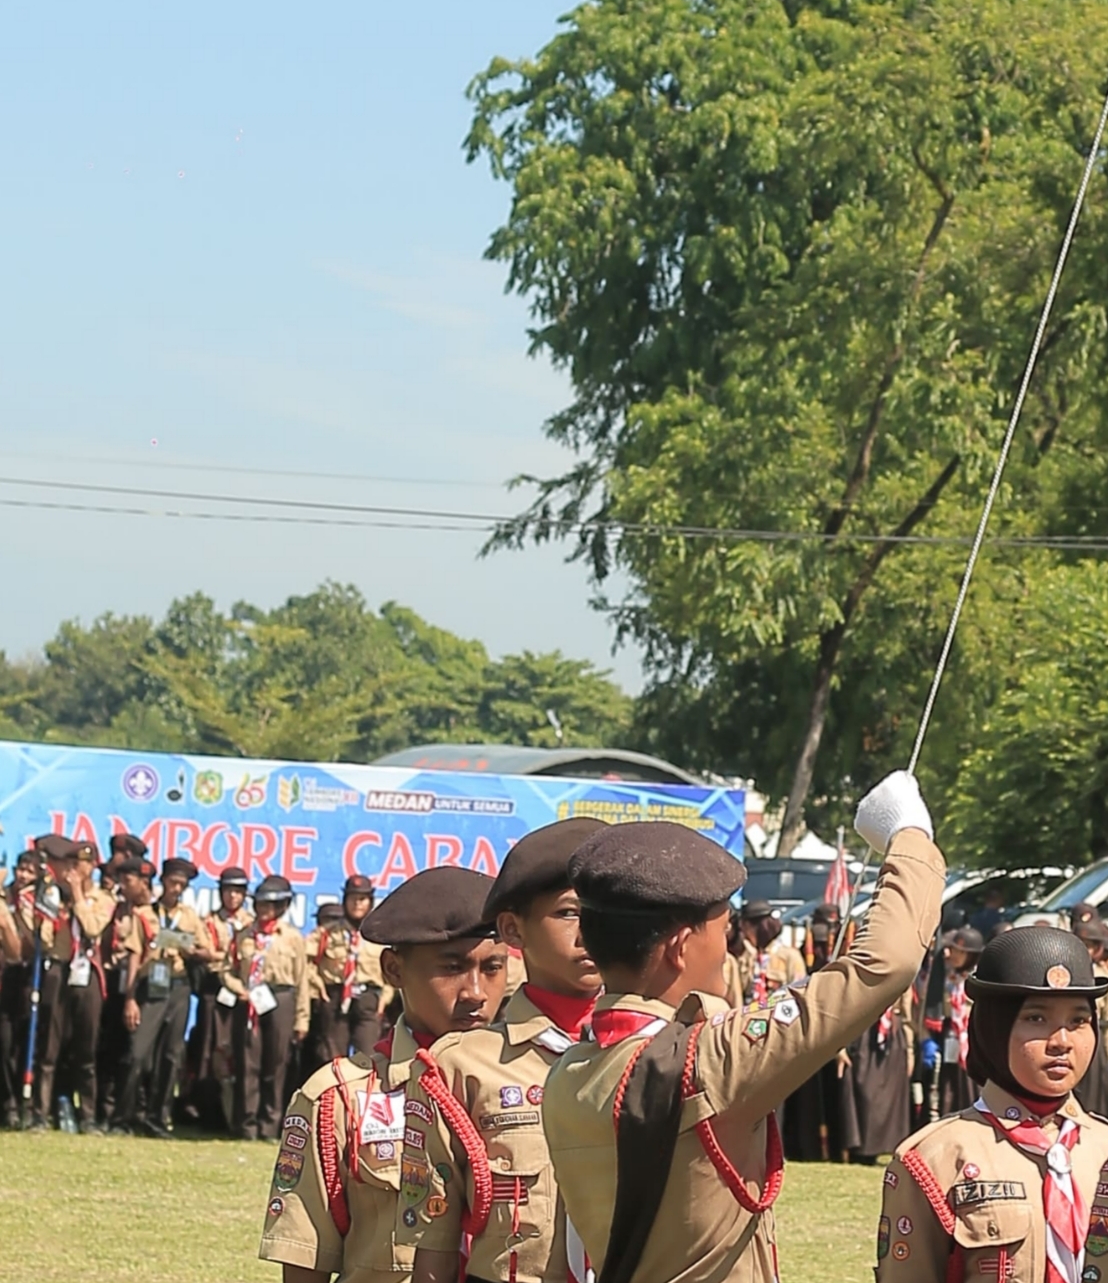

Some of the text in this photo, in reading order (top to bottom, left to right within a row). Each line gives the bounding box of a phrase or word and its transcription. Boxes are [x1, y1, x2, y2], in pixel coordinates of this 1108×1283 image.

[368, 792, 433, 811] MEDAN
[435, 799, 470, 811] UNTUK
[473, 800, 510, 813] SEMUA
[342, 829, 518, 888] CABA
